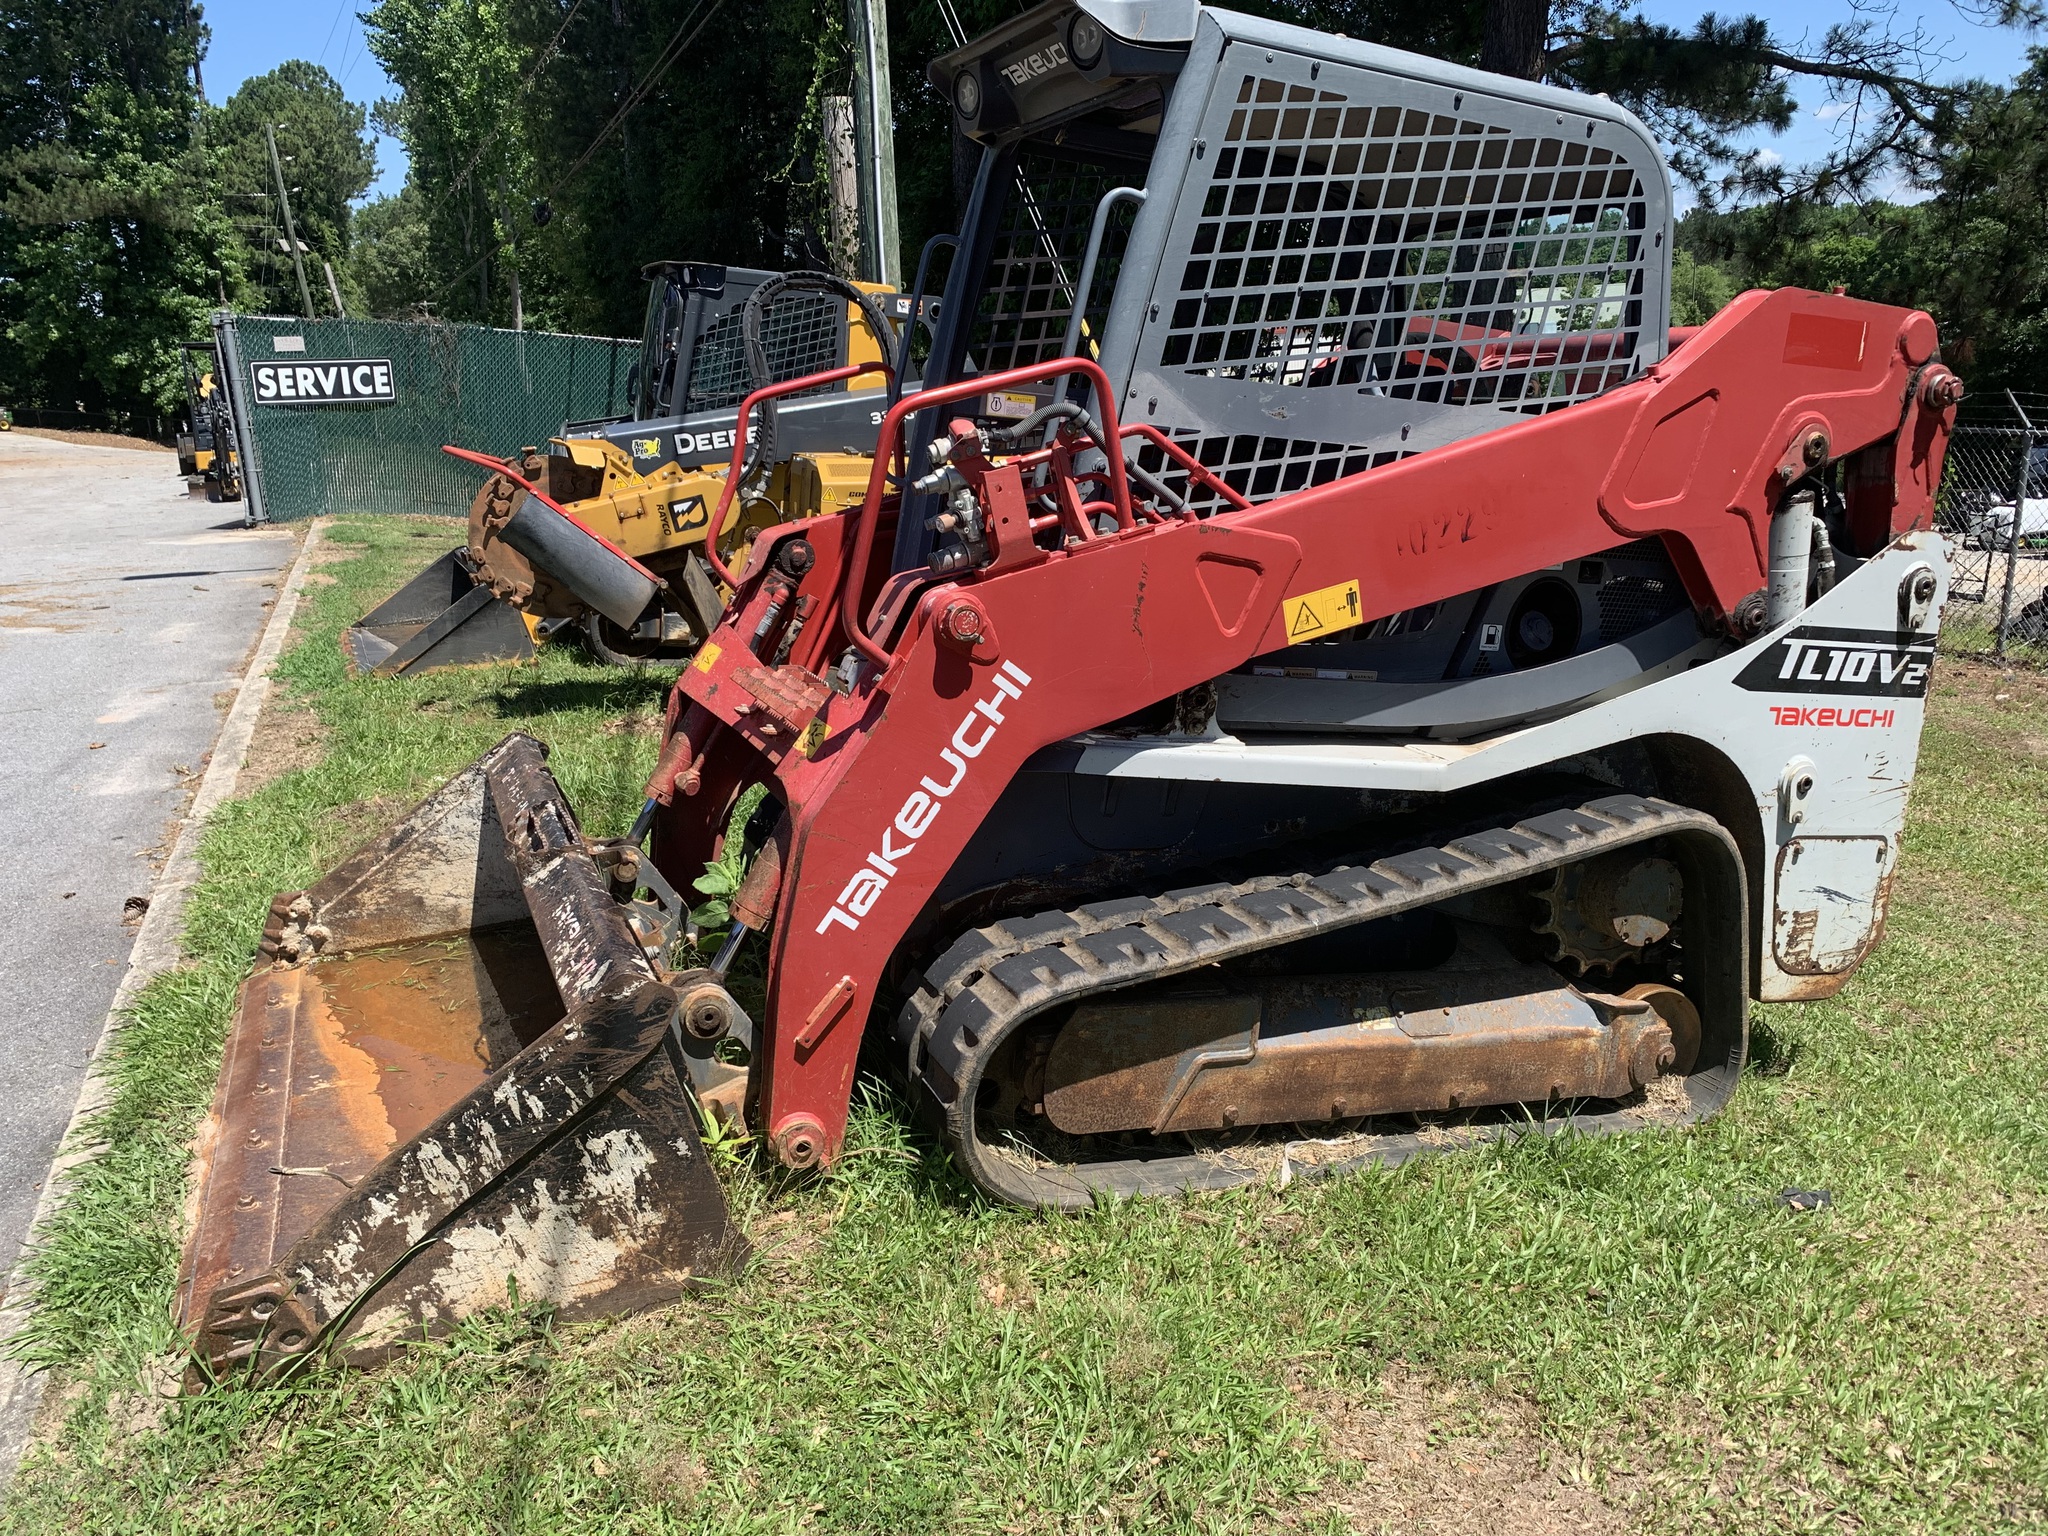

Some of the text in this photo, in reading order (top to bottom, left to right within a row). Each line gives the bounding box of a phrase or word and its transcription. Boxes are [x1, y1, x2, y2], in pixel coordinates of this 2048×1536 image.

[1001, 41, 1069, 86] TAKEUC
[257, 365, 391, 398] SERVICE
[635, 448, 648, 456] Pro
[656, 503, 672, 536] RAYCO
[1778, 638, 1935, 685] TL10V2
